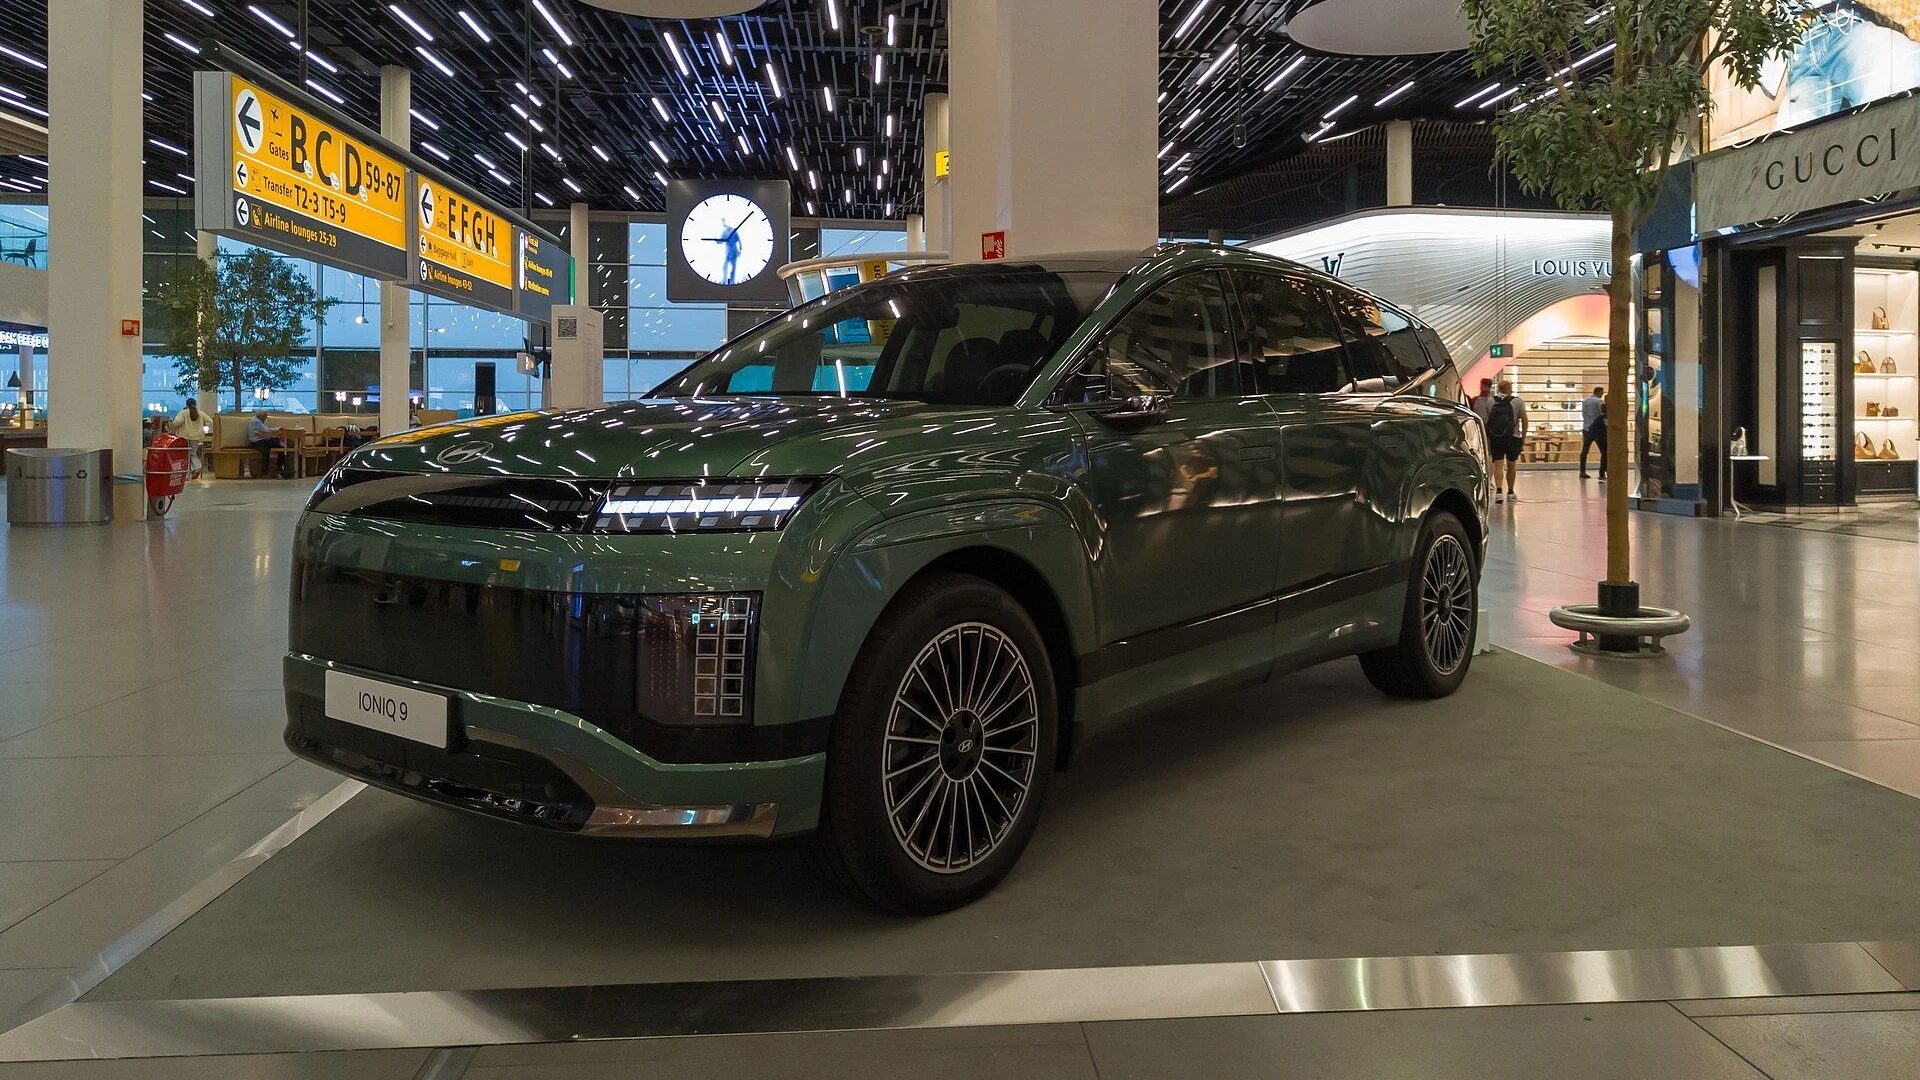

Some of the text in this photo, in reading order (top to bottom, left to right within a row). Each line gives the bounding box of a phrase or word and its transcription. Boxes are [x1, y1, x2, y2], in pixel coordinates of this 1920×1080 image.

[269, 113, 401, 203] Gates B C D 59-87
[1765, 127, 1897, 190] GUCCI
[263, 176, 346, 223] Transfer T2-3 T5-9
[264, 212, 337, 248] Airline lounges 25-29
[436, 218, 448, 231] Gates
[448, 196, 457, 240] E
[461, 203, 469, 243] F
[472, 210, 483, 251] G
[485, 216, 495, 256] H
[434, 269, 448, 283] Airline
[448, 272, 462, 289] lounges
[1533, 259, 1587, 277] LOUIS
[358, 691, 408, 723] IONIQ 9
